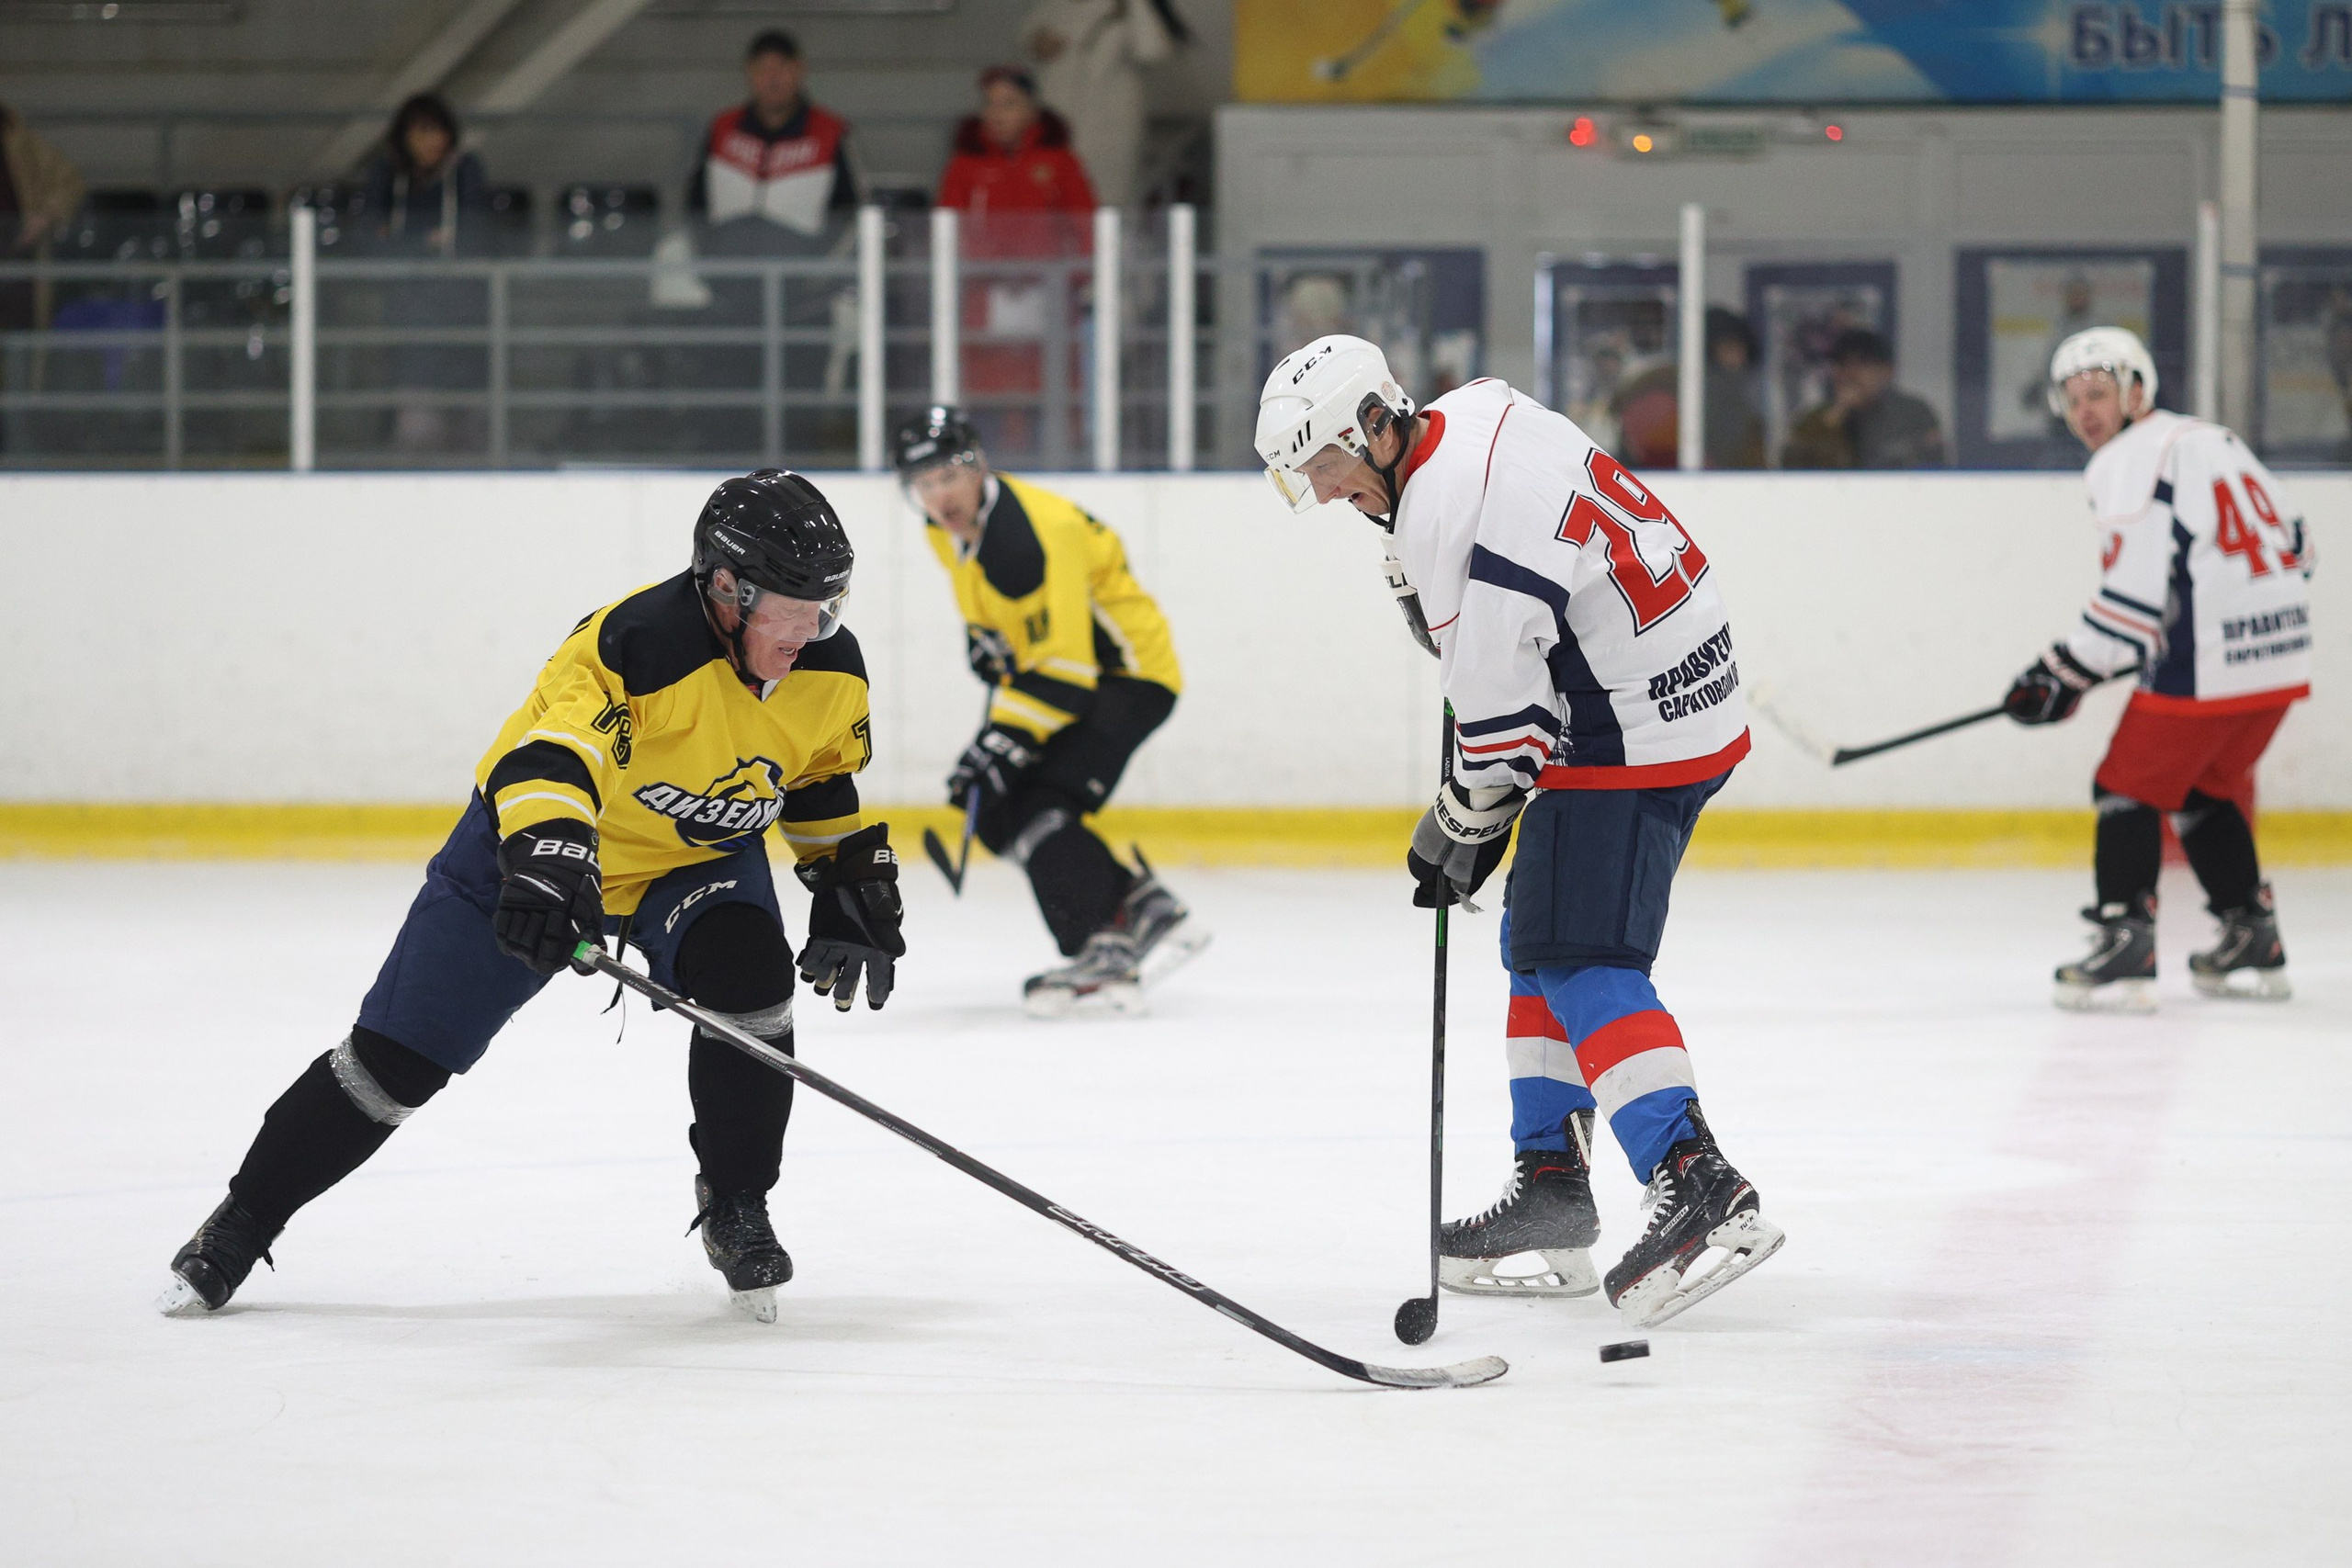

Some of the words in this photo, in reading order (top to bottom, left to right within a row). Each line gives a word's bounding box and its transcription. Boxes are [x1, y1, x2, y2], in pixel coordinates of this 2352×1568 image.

[1293, 345, 1332, 385] CCM
[1555, 446, 1710, 637] 29
[2212, 470, 2300, 577] 49
[1647, 621, 1733, 701] ПРАВИТЕЛ
[639, 784, 784, 829] ДИЗЕЛИ
[1435, 792, 1521, 839] HESPELE
[664, 879, 738, 934] CCM
